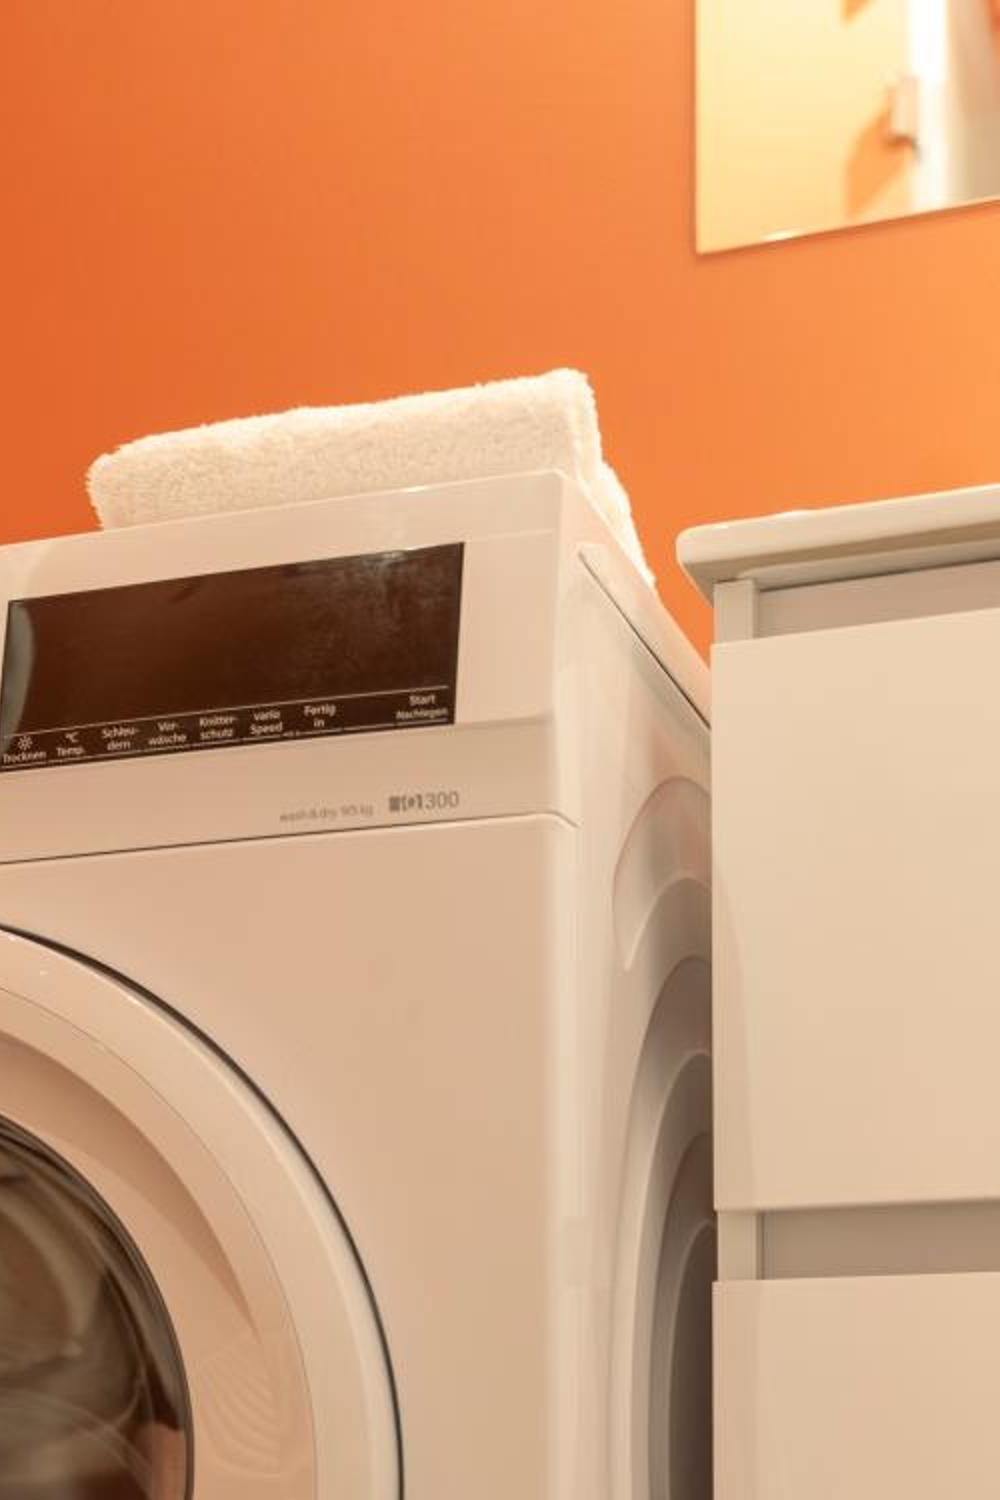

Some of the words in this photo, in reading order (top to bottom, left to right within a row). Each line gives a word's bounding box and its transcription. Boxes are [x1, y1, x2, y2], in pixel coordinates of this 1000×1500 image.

[408, 693, 436, 706] Start
[303, 703, 337, 717] Fertig
[250, 721, 284, 735] Speed
[313, 716, 326, 728] in
[106, 739, 132, 751] dern
[2, 750, 48, 764] Trocknen
